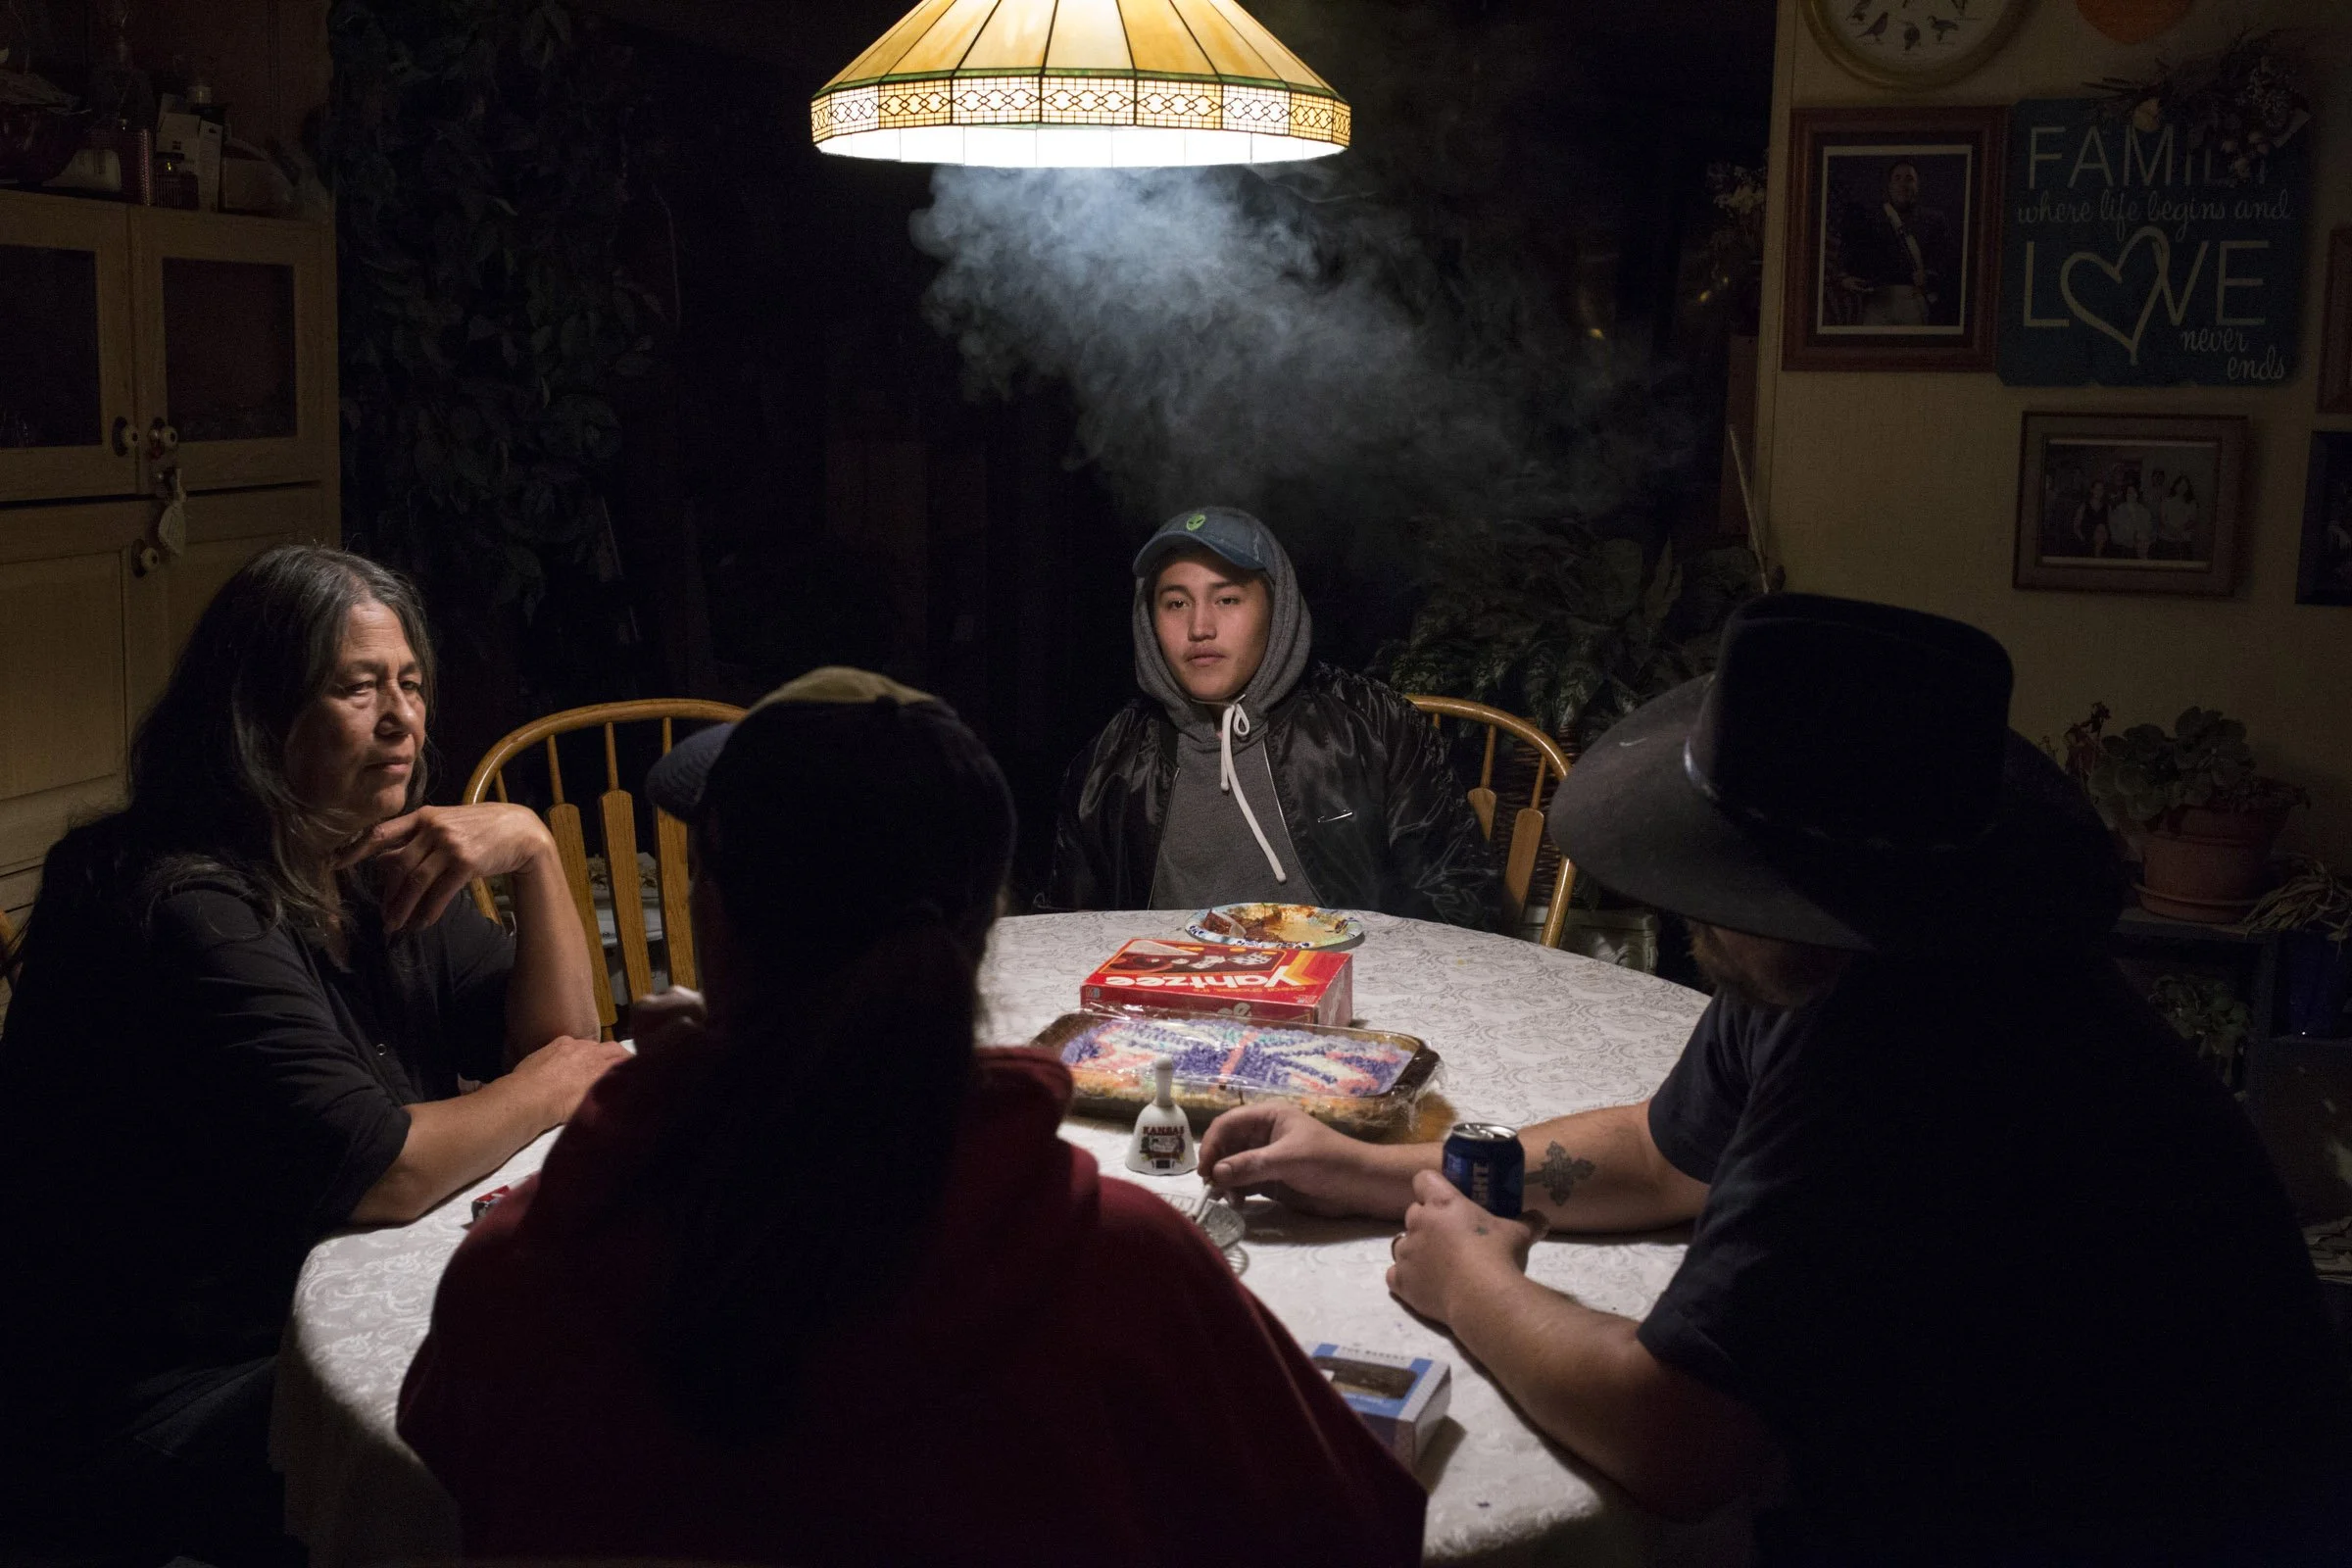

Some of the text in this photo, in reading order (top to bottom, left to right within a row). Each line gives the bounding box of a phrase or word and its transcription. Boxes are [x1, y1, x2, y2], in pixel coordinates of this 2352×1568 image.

[2018, 189, 2290, 243] where life begins and
[2180, 327, 2249, 353] never
[2227, 344, 2285, 380] ends
[1105, 965, 1301, 989] Yahtzee
[1143, 1126, 1185, 1136] KANSAS
